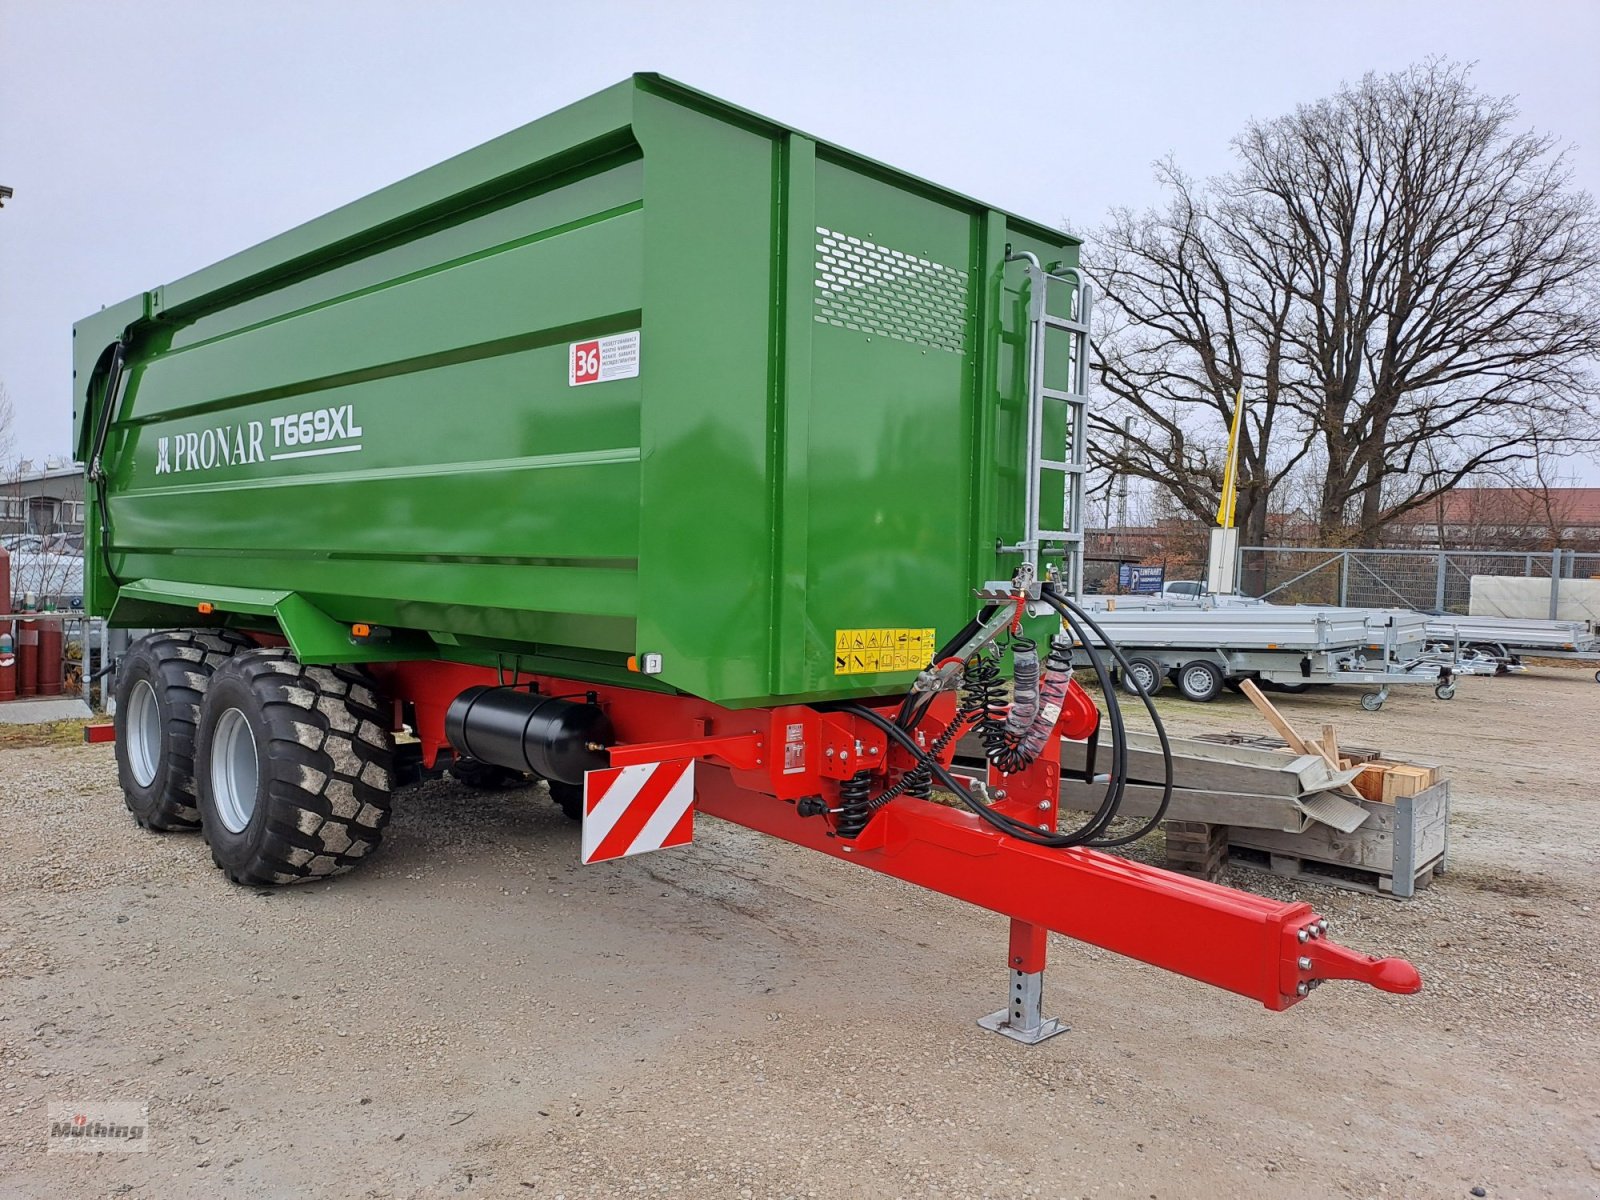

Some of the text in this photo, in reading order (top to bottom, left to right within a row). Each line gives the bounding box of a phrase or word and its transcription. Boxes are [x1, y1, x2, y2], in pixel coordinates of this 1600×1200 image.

[577, 348, 598, 376] 36
[174, 404, 363, 473] PRONAR T669XL
